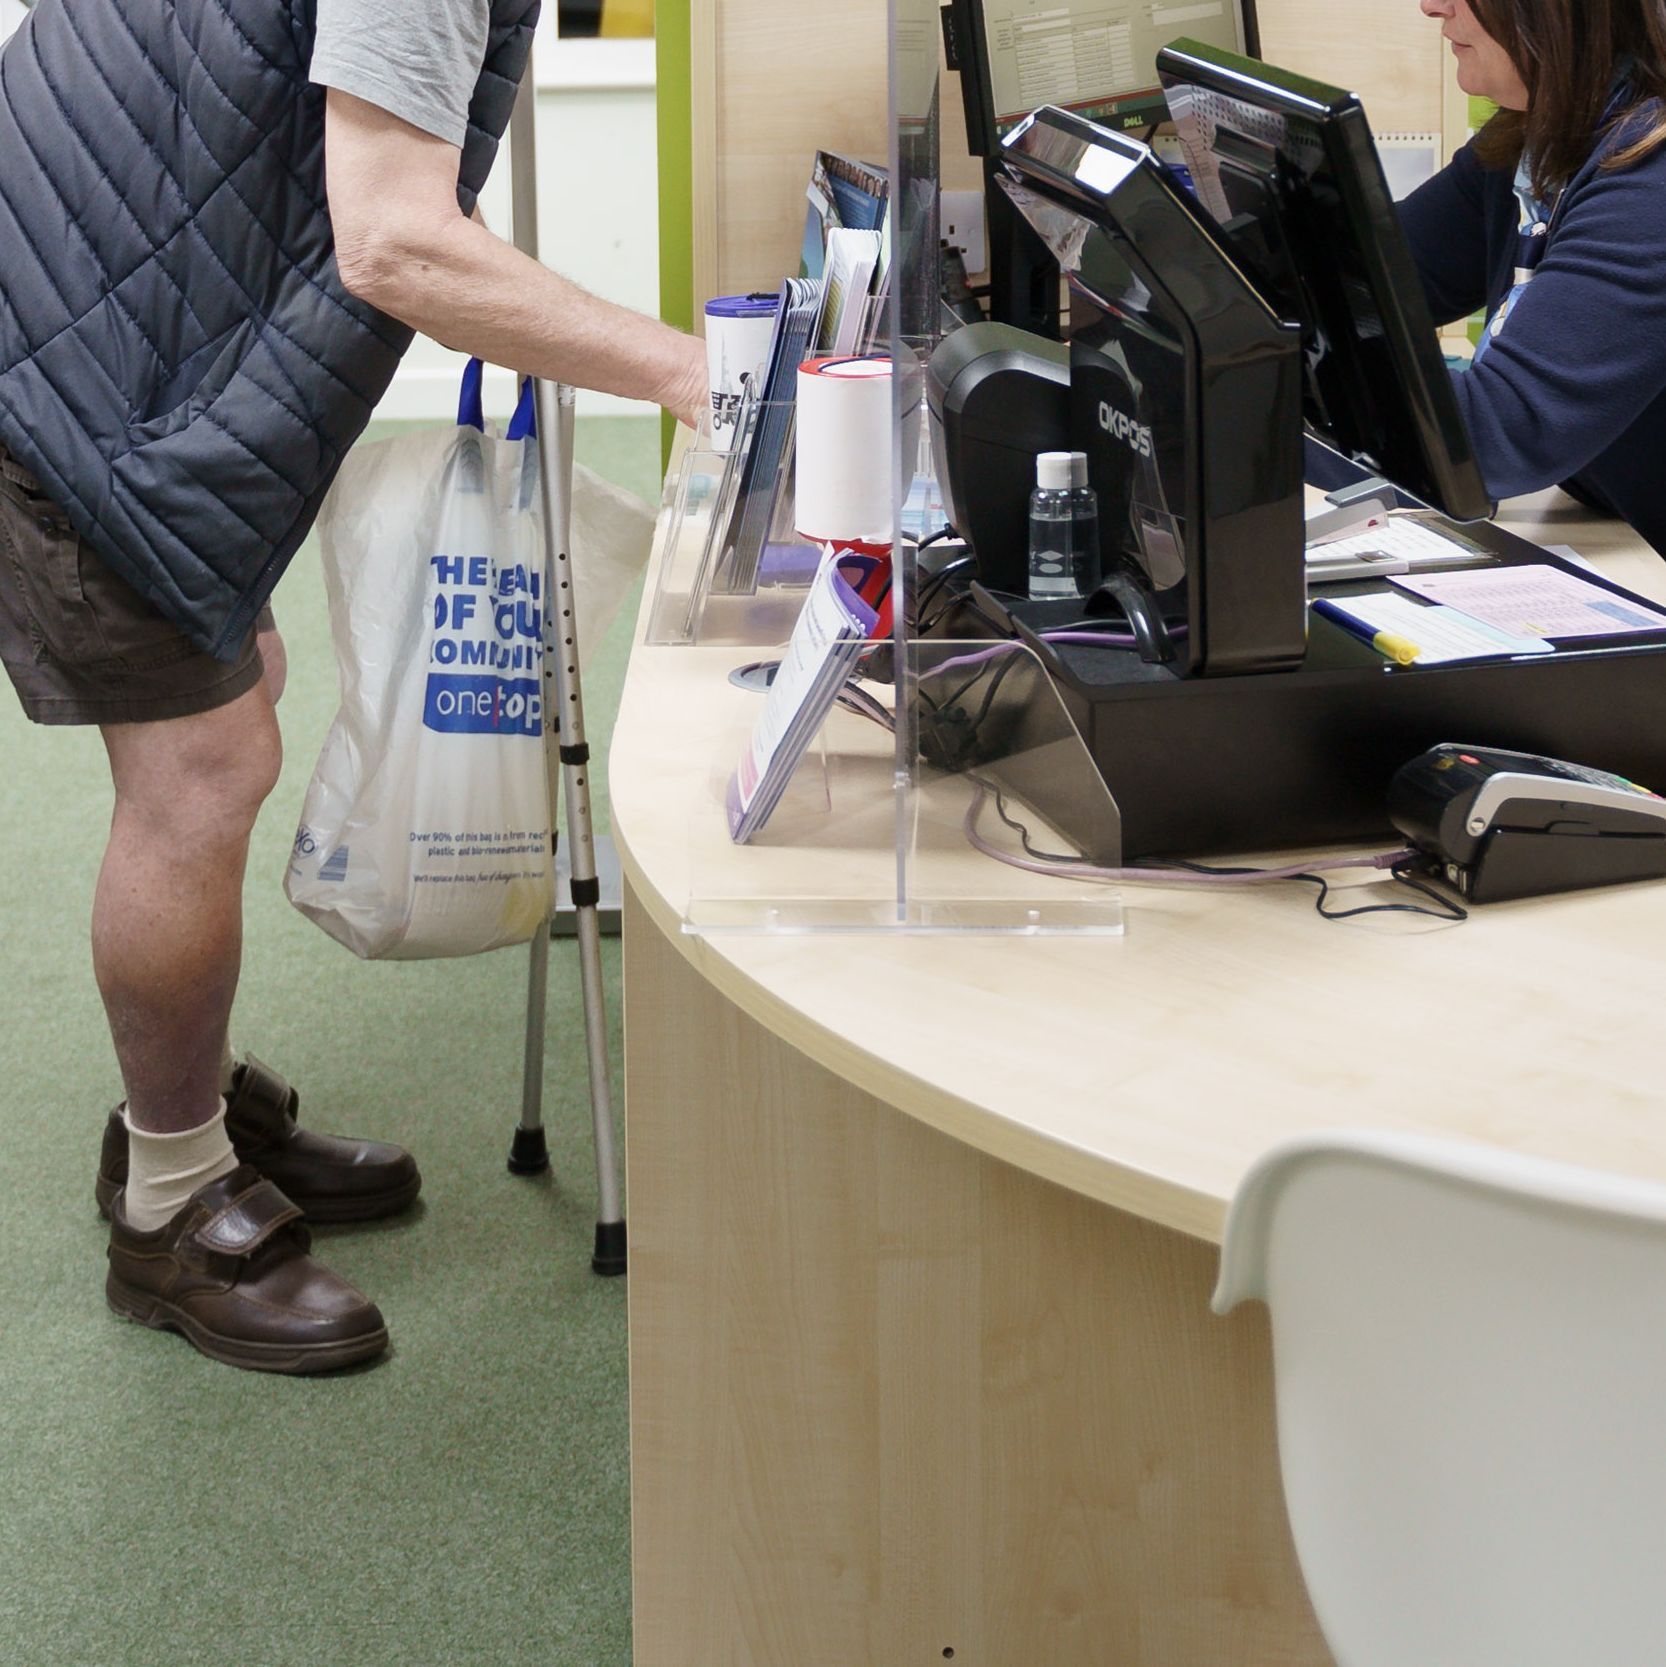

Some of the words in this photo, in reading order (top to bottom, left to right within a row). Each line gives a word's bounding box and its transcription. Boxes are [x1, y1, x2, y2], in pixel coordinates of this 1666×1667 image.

[1124, 115, 1144, 128] DELL
[1099, 400, 1151, 458] OKPOS
[410, 831, 430, 842] Over
[432, 831, 452, 842] 90%
[455, 832, 465, 842] of
[479, 832, 492, 843] bag
[493, 831, 501, 841] is
[428, 846, 455, 858] plastic
